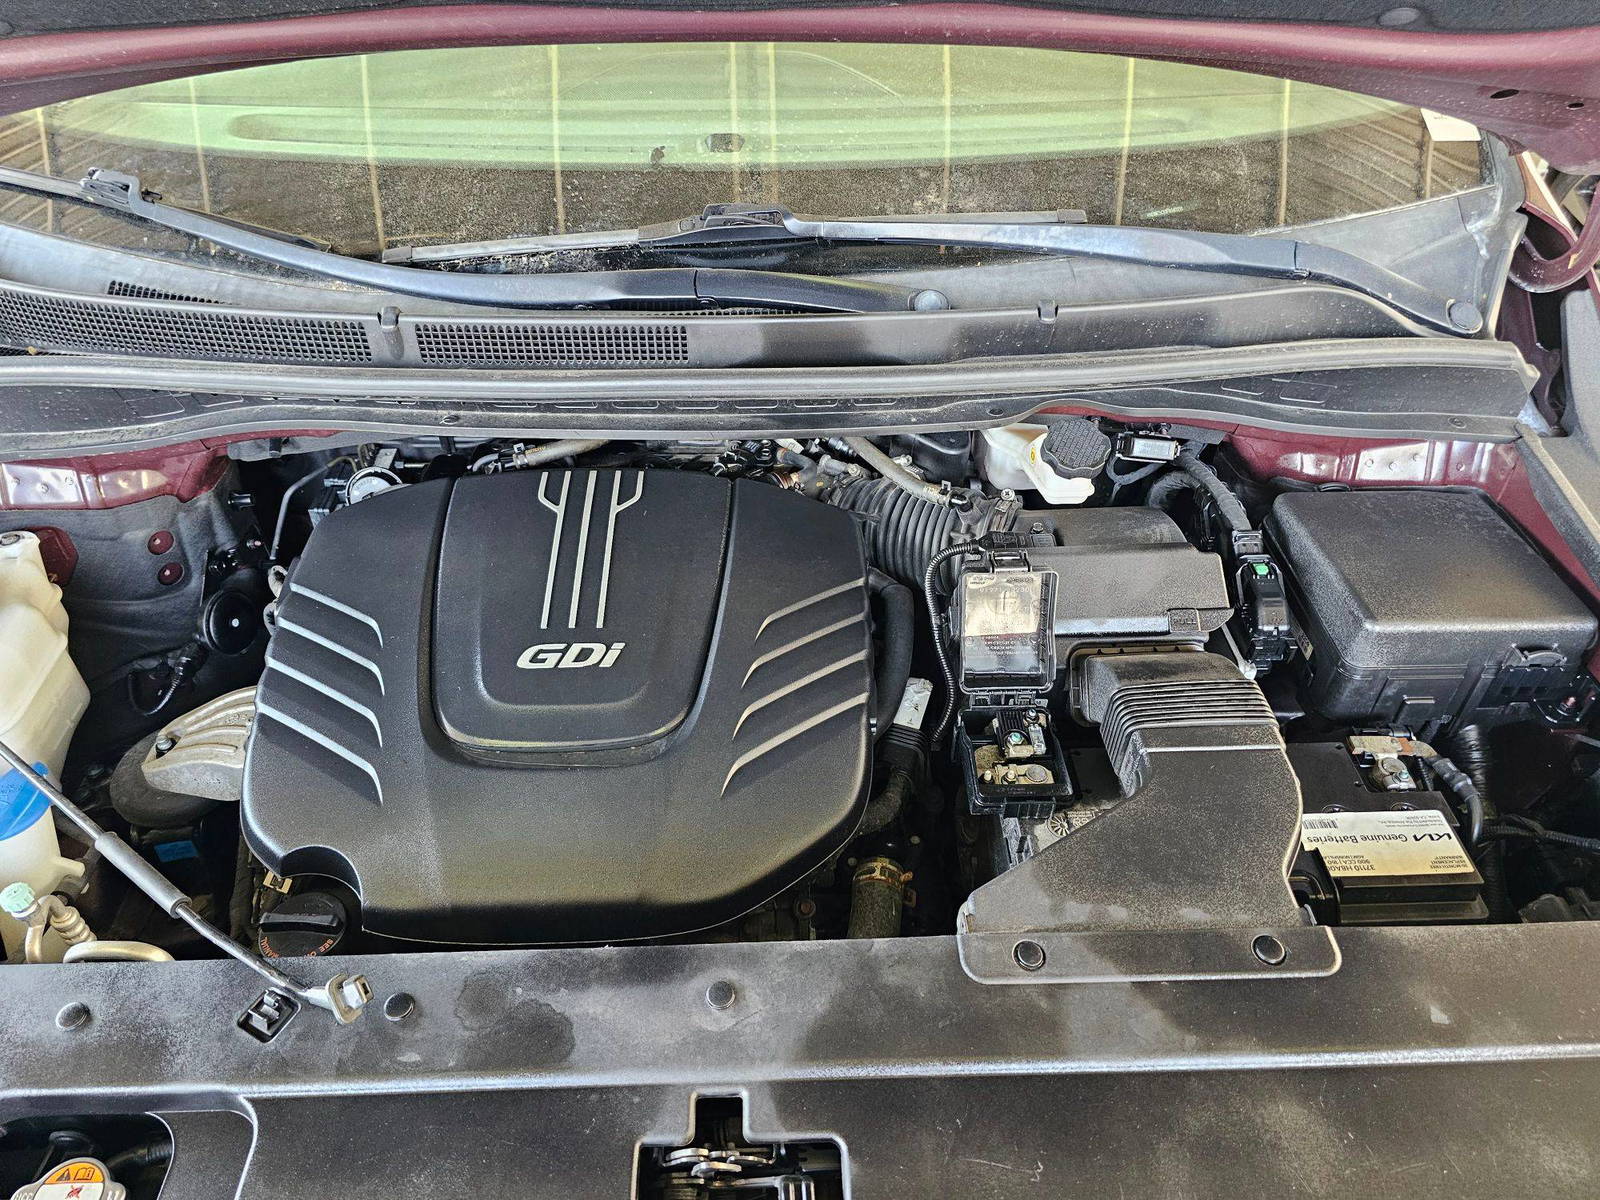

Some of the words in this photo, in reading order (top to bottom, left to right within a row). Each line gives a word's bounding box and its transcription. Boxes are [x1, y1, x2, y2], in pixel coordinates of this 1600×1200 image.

[516, 642, 626, 669] GDi
[1306, 834, 1358, 845] Batteries
[1360, 833, 1408, 843] Genuine
[1412, 832, 1452, 842] KIA
[1354, 864, 1375, 872] 37110
